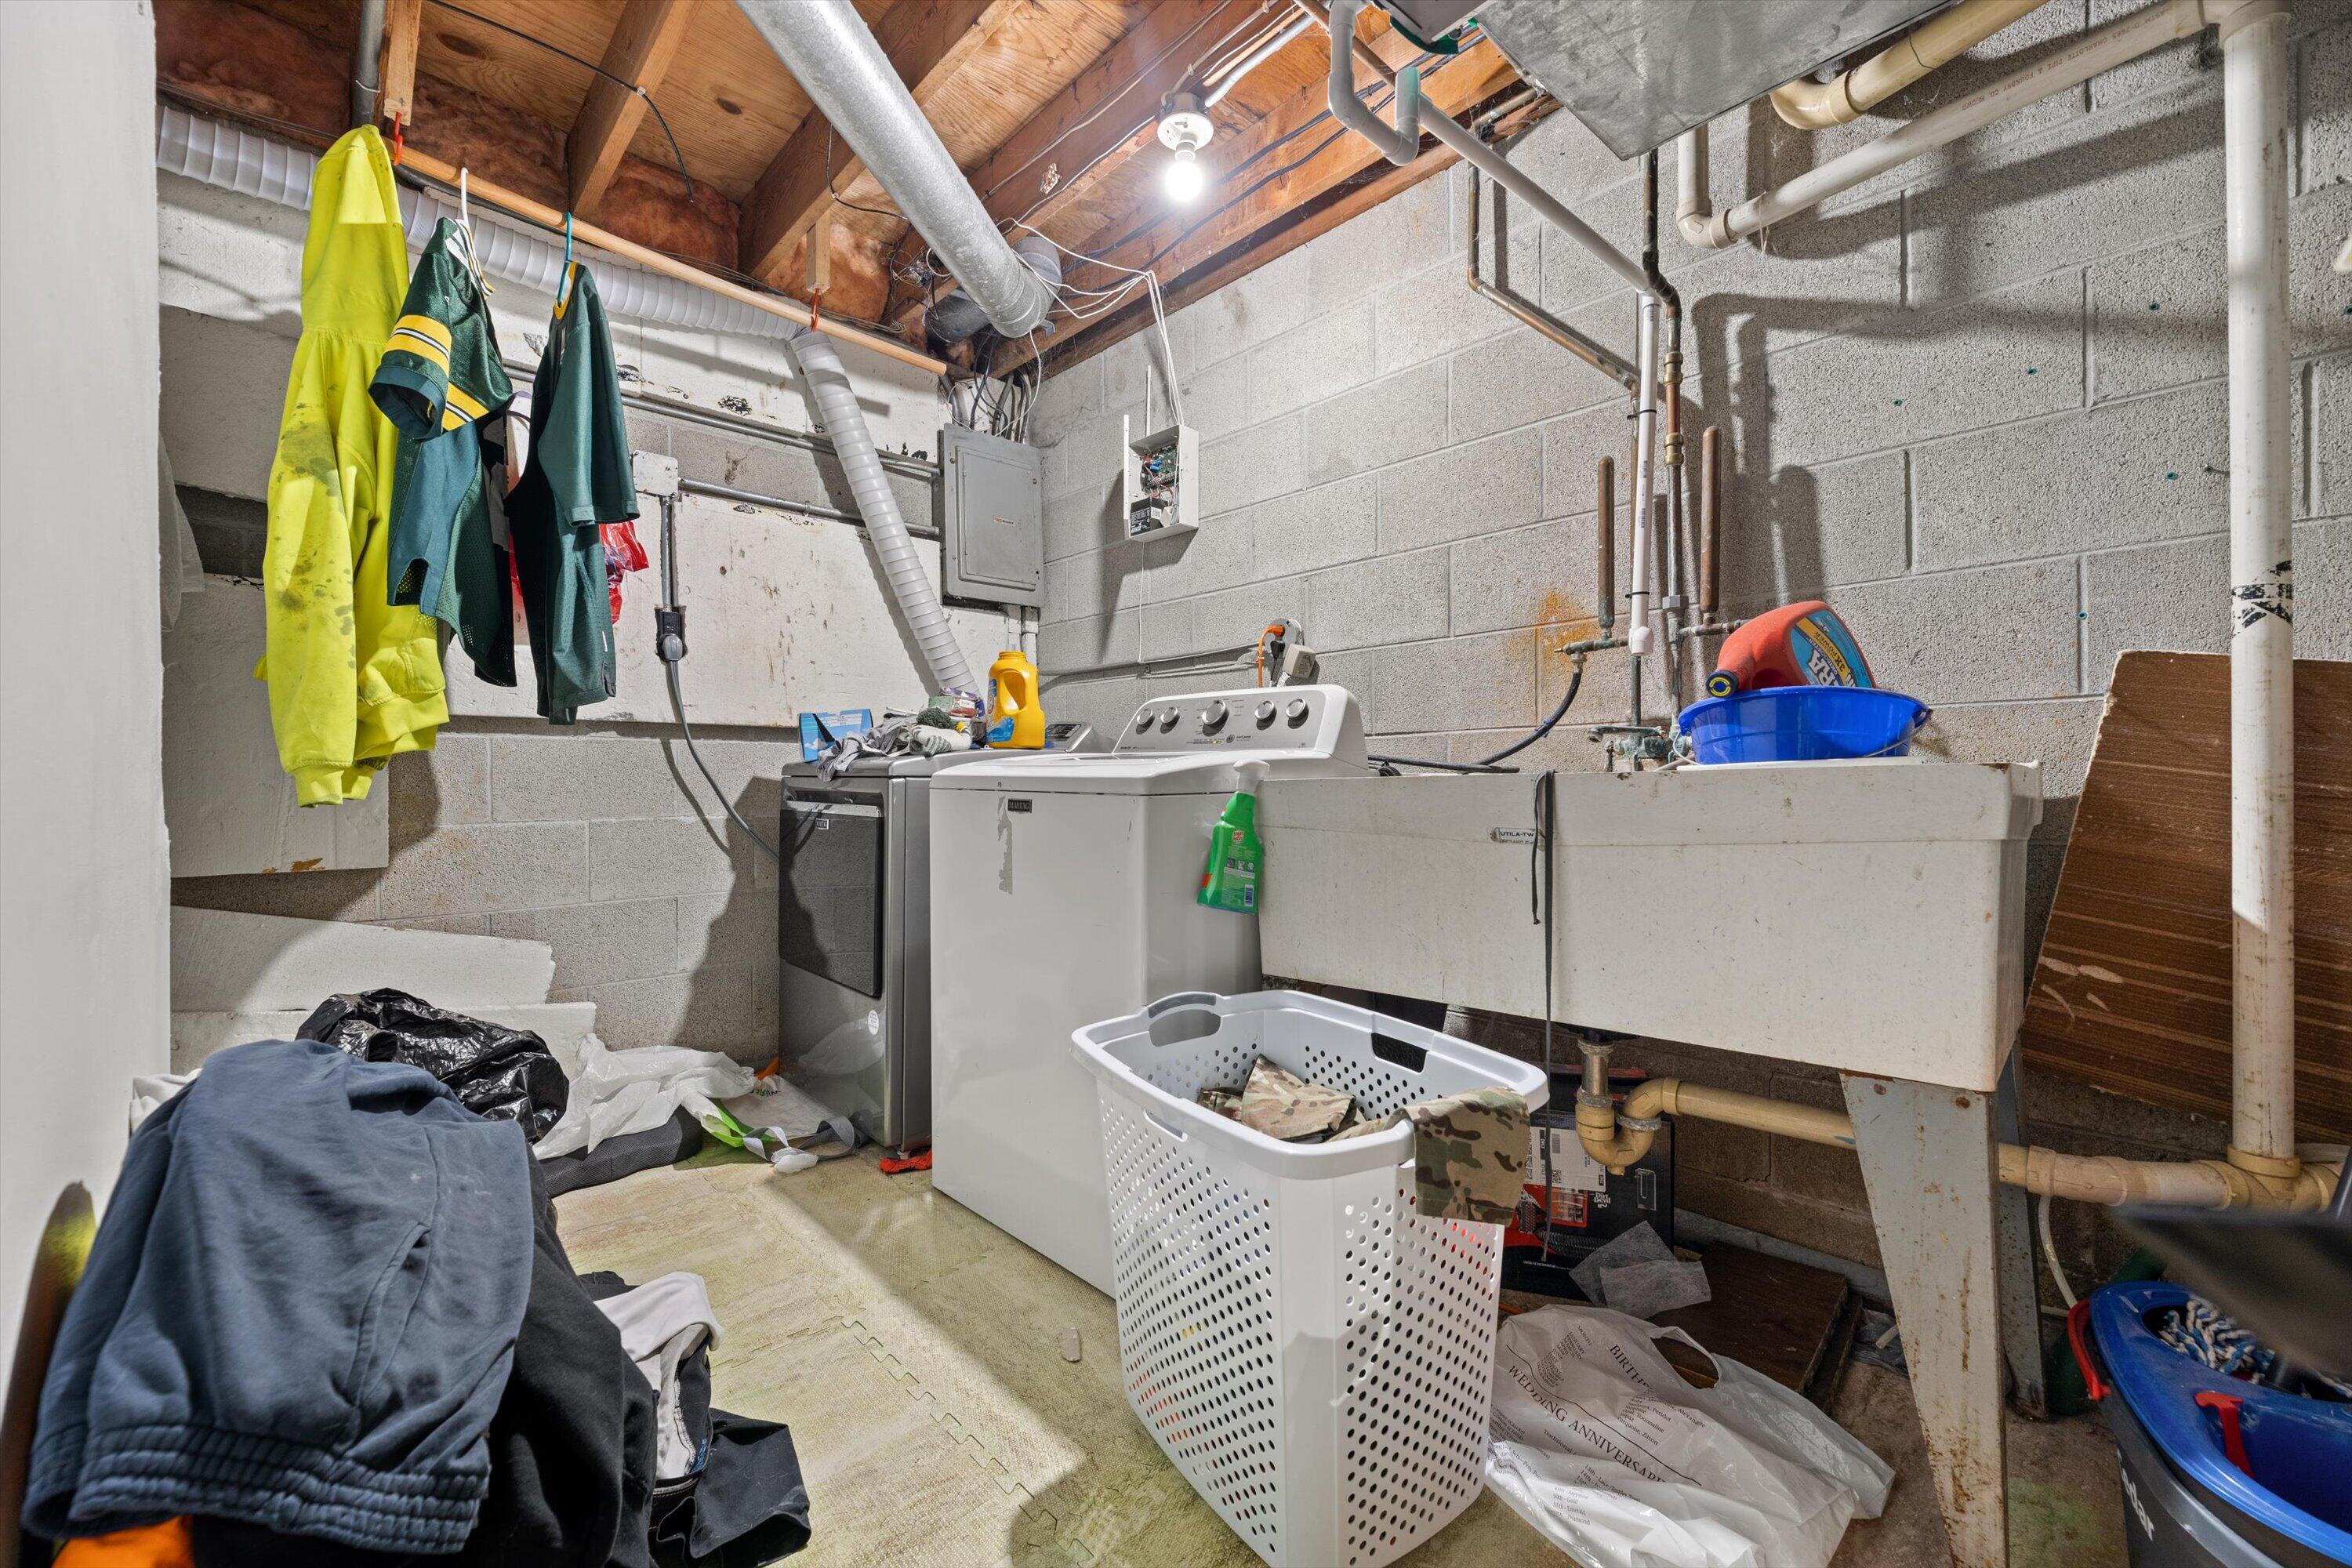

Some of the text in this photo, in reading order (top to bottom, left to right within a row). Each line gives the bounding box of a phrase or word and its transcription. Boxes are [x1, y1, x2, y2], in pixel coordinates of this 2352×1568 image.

[2067, 37, 2107, 61] CHARLOTTE
[2048, 59, 2063, 71] PIPE
[2003, 71, 2034, 93] FOUNDRY
[1813, 631, 1837, 656] POWER
[1808, 648, 1838, 686] RA
[1833, 655, 1845, 672] 3X
[1577, 1324, 1592, 1345] MONTH
[1508, 1365, 1568, 1423] WEDDING
[1636, 1414, 1665, 1434] Tourmaline
[1653, 1407, 1671, 1422] Peridot
[1543, 1428, 1573, 1454] Traditional
